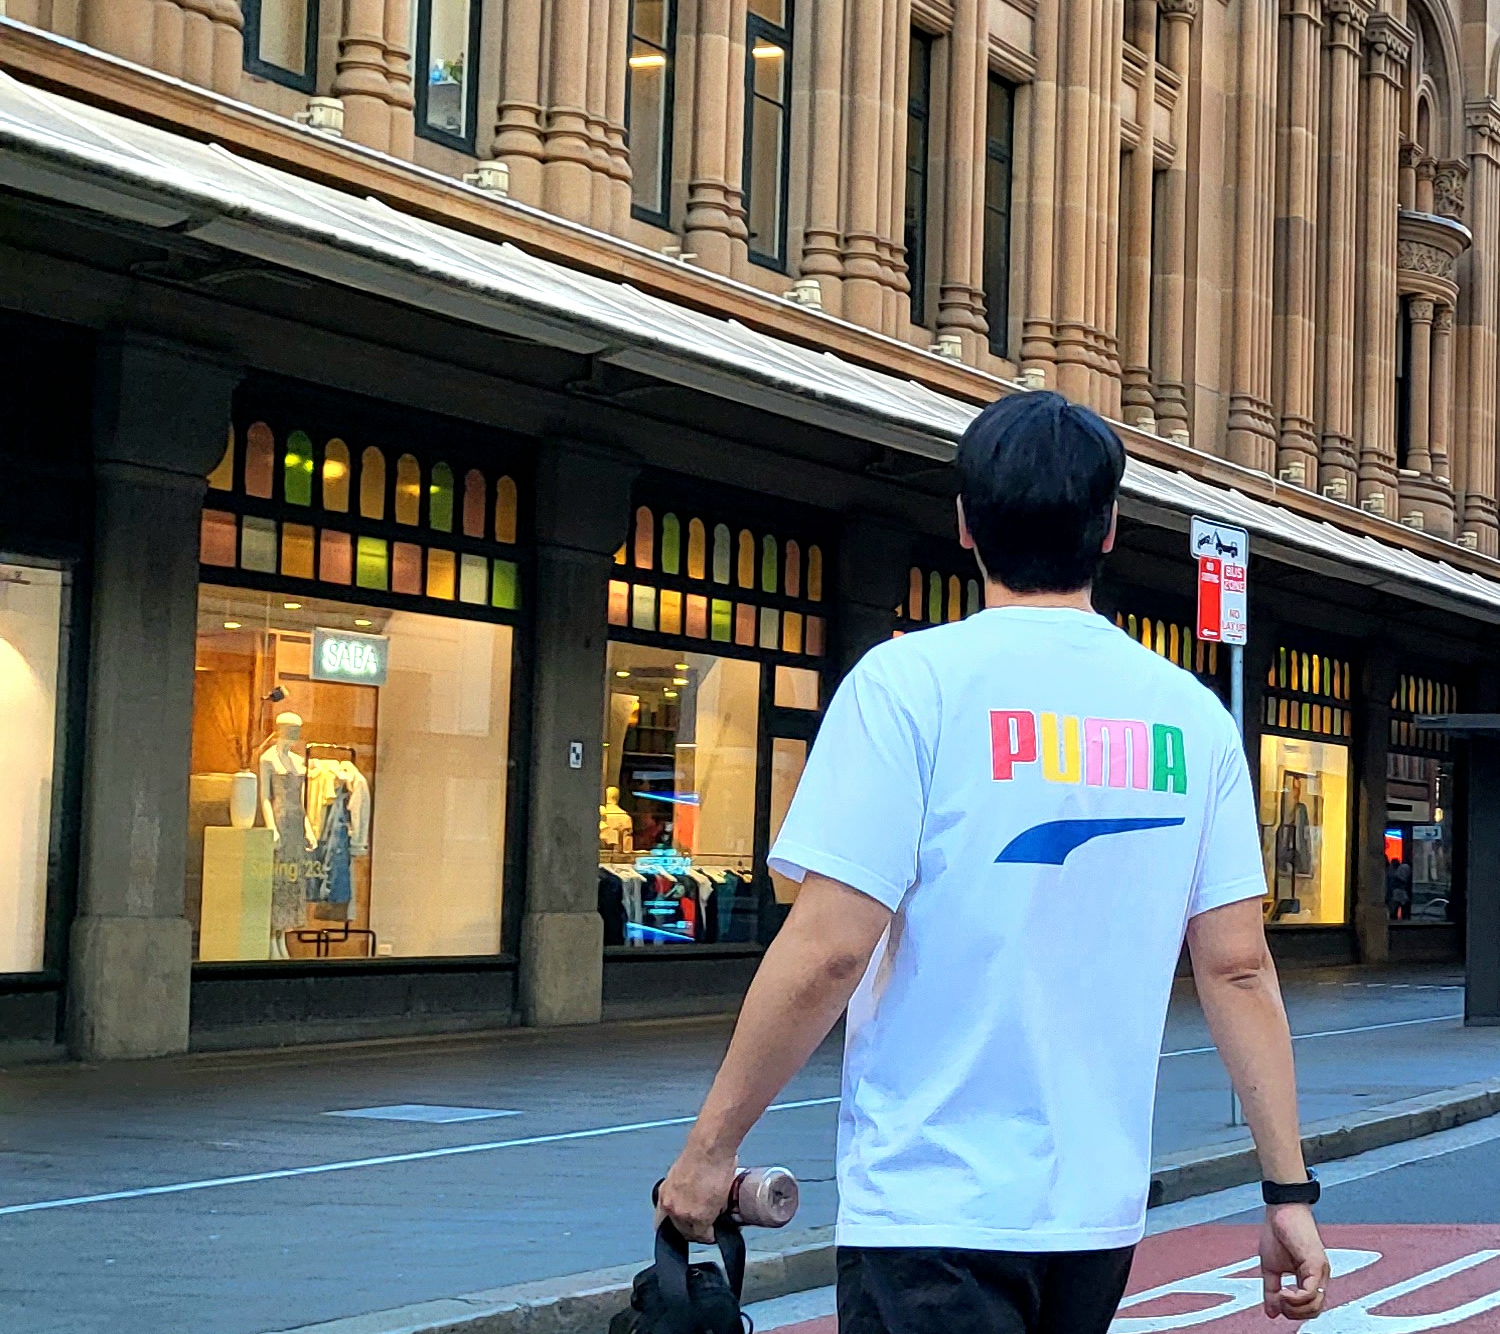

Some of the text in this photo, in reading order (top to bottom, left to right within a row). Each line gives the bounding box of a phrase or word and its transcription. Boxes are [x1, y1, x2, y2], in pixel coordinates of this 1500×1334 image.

[1226, 566, 1243, 579] BUS
[323, 638, 379, 674] SABA
[988, 709, 1188, 795] PUMA
